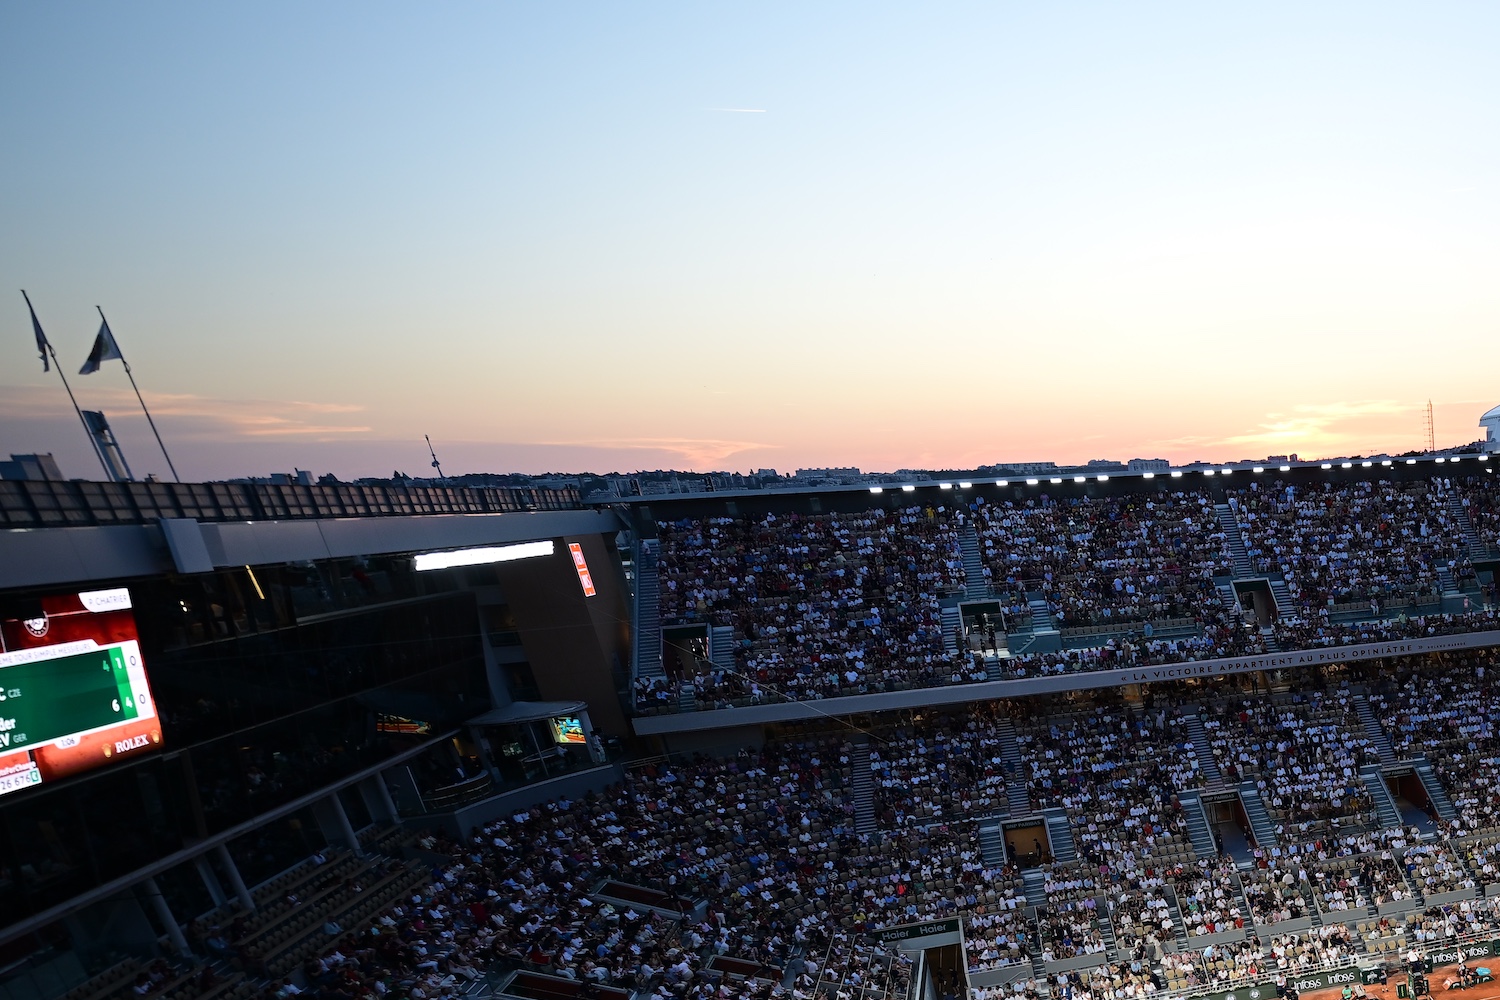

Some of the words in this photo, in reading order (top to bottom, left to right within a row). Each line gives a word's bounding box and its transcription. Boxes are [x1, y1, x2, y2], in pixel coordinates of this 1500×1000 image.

[103, 660, 110, 672] 4
[115, 657, 122, 669] 1
[130, 656, 136, 666] 0
[1133, 673, 1147, 681] LA
[1154, 665, 1213, 678] VICTOIRE
[1220, 657, 1294, 671] APPARTIENT
[1300, 655, 1313, 663] AU
[1320, 652, 1346, 661] PLUS
[1352, 644, 1413, 657] OPINIÂTRE
[7, 688, 22, 698] CZE
[139, 694, 146, 704] 0
[112, 699, 120, 712] 6
[125, 696, 133, 708] 4
[13, 733, 27, 743] GER
[114, 734, 149, 753] ROLEX
[1, 780, 12, 790] 26
[882, 930, 909, 940] Haier
[920, 924, 946, 934] Haier
[1328, 972, 1356, 984] Infosys
